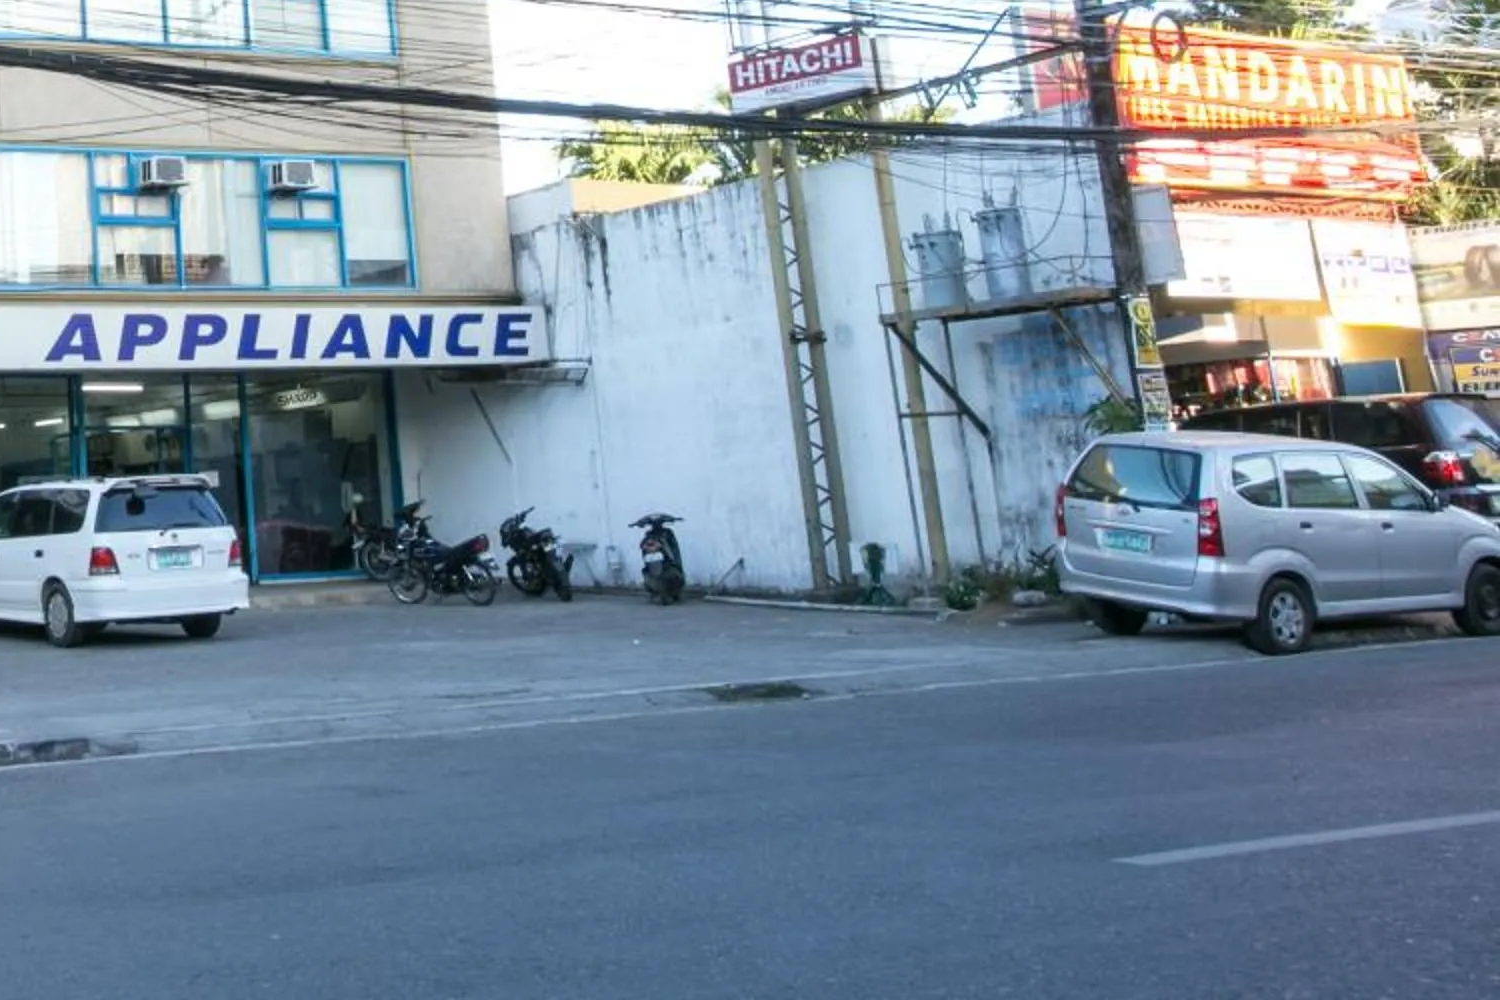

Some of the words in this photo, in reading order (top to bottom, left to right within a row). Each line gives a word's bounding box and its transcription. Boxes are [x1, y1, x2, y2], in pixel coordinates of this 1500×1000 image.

[734, 40, 854, 88] HITACHI
[1120, 35, 1406, 119] MANDARIN
[43, 312, 533, 362] APPLIANCE
